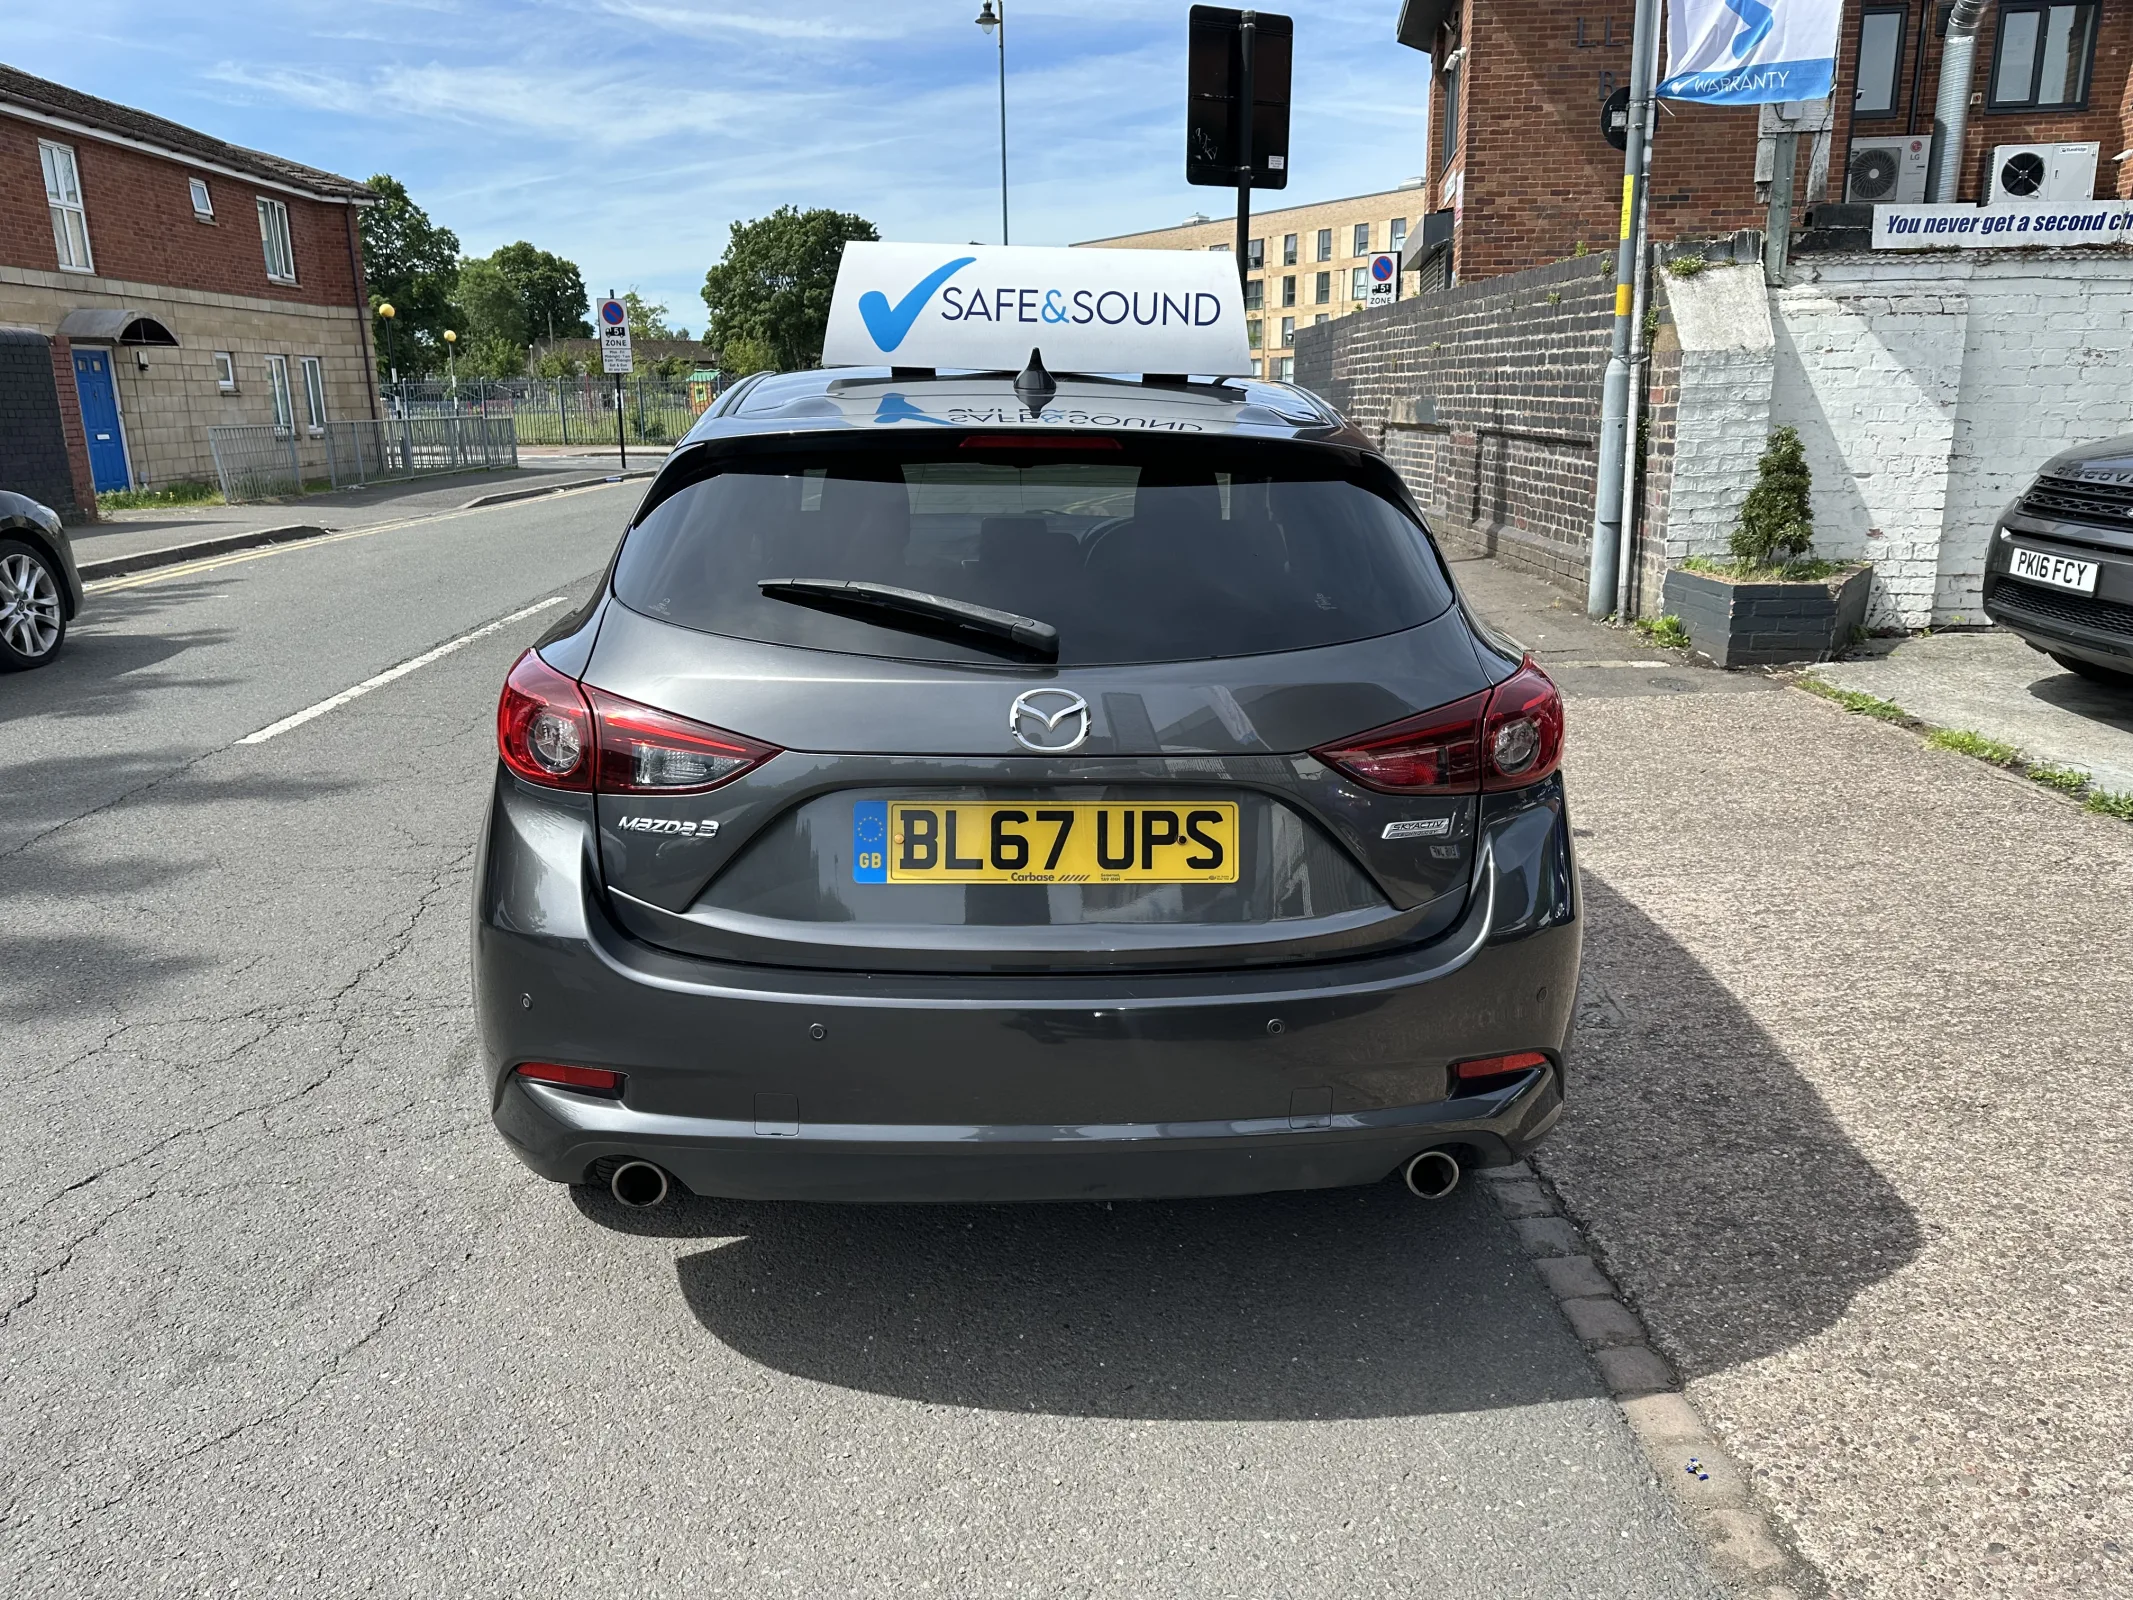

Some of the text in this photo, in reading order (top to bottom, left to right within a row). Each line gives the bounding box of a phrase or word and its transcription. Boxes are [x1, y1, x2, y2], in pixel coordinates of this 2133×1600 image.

[1576, 16, 1634, 48] LL
[1694, 70, 1790, 93] WARRANTY
[1887, 214, 1921, 234] You
[1922, 216, 1980, 234] never
[1980, 213, 2016, 235] get
[2016, 215, 2031, 232] a
[2033, 211, 2108, 232] second
[941, 286, 1221, 326] SAFE&SOUND
[605, 339, 627, 347] ZONE
[2053, 466, 2133, 483] DISCOV
[2017, 551, 2088, 586] PK16 FCY
[1392, 820, 1444, 830] SKYACTIV
[900, 810, 1224, 870] BL67 UPS
[858, 852, 882, 869] GB
[1011, 871, 1055, 882] Carbase
